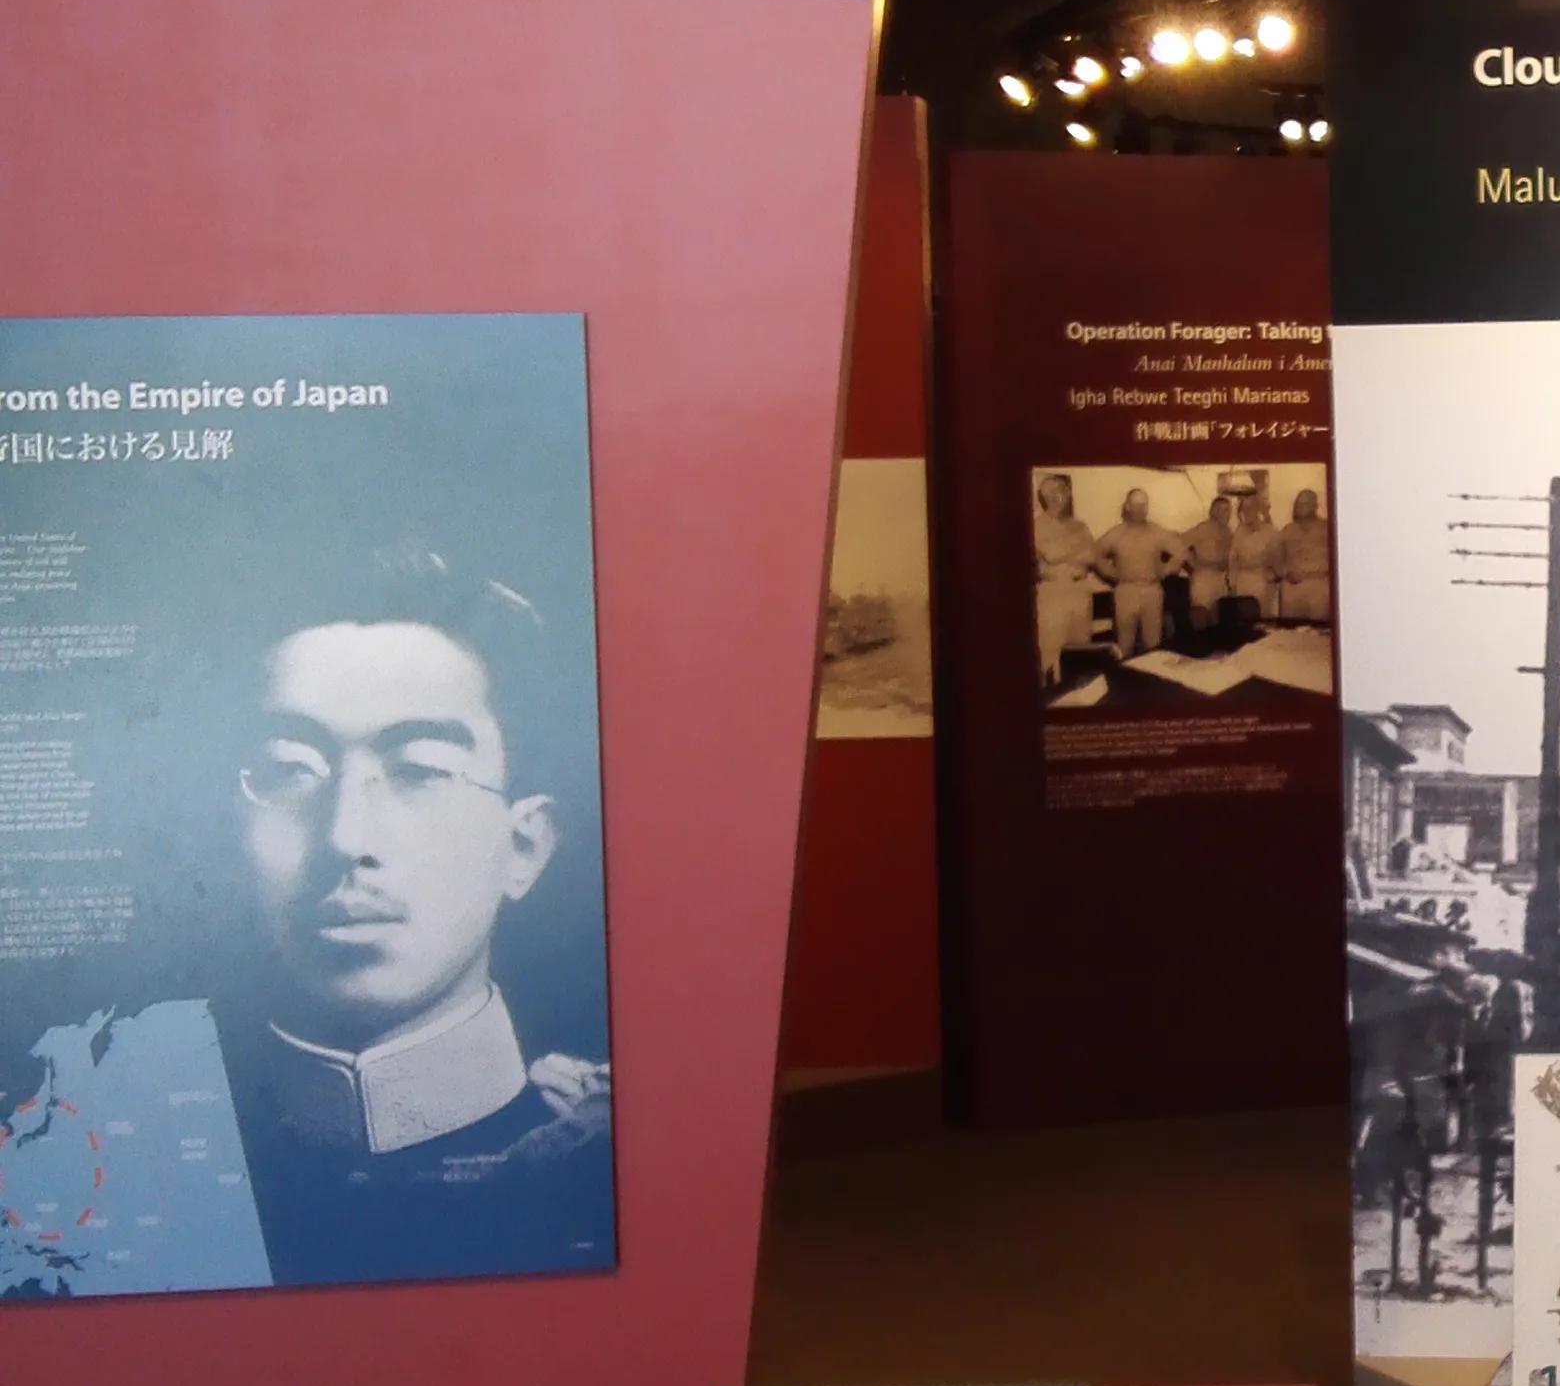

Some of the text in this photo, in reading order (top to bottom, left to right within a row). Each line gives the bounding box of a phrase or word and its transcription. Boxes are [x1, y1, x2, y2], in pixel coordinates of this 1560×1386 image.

[1066, 321, 1323, 345] Operation Forager: Taking
[1278, 354, 1285, 371] i
[66, 383, 121, 410] the
[129, 381, 245, 415] Empire
[252, 379, 286, 407] of
[292, 379, 388, 412] Japan
[1070, 388, 1107, 410] Igha
[1232, 386, 1310, 404] Marianas
